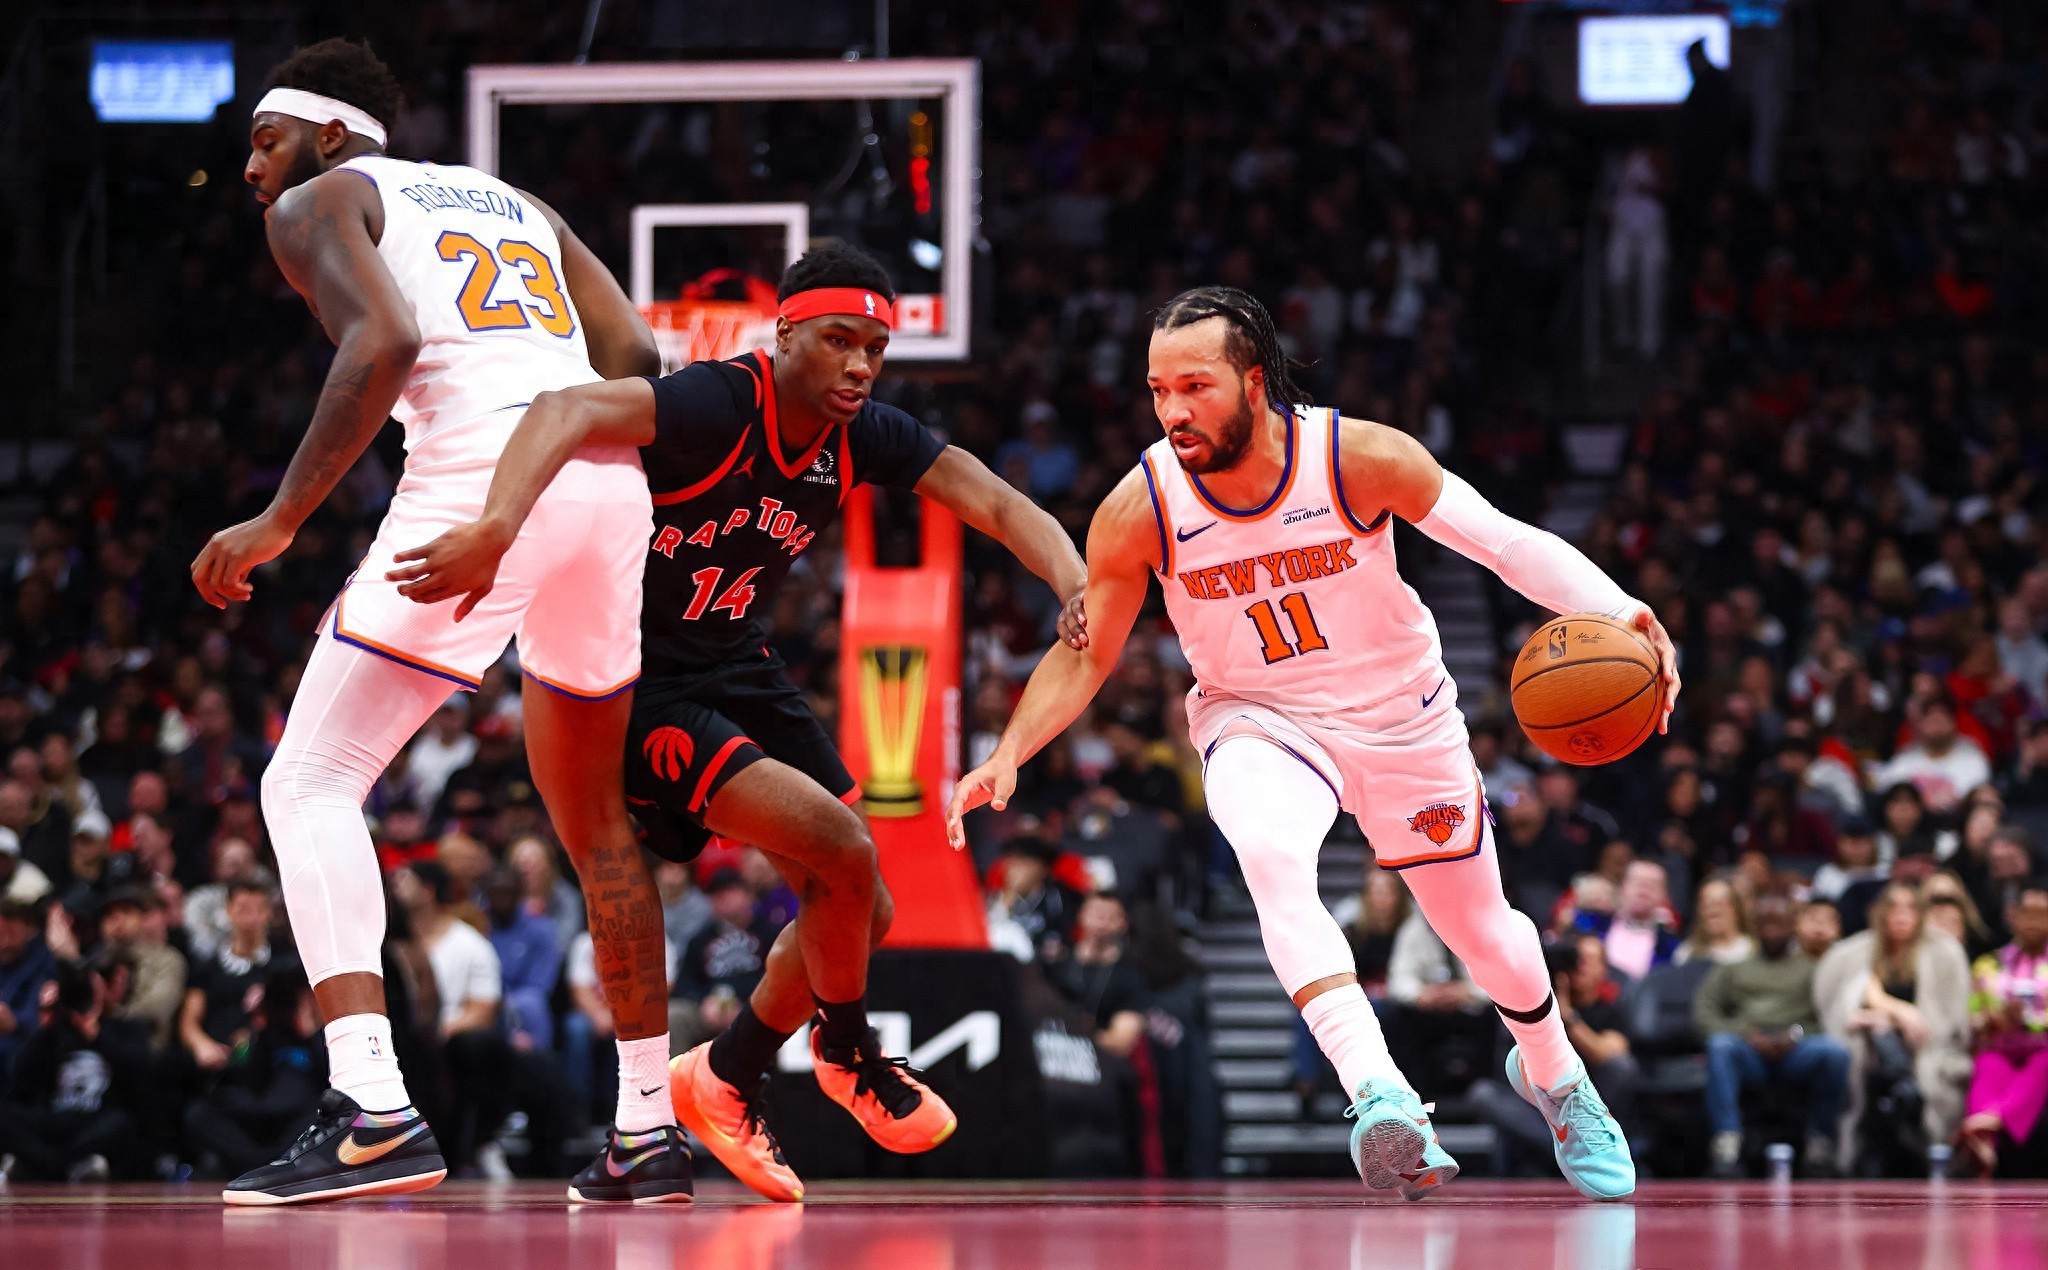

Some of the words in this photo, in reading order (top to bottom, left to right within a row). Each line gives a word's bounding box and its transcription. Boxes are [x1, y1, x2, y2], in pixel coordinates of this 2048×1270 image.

[400, 184, 523, 224] ROBINSON
[435, 230, 576, 339] 23
[652, 496, 816, 559] RAPTORS
[1283, 515, 1302, 525] abu
[1302, 506, 1331, 520] dhabi
[682, 566, 766, 620] 14
[1178, 557, 1256, 600] NEW
[1259, 538, 1357, 588] YORK
[1244, 592, 1329, 665] 11
[1411, 805, 1465, 831] KNICKS
